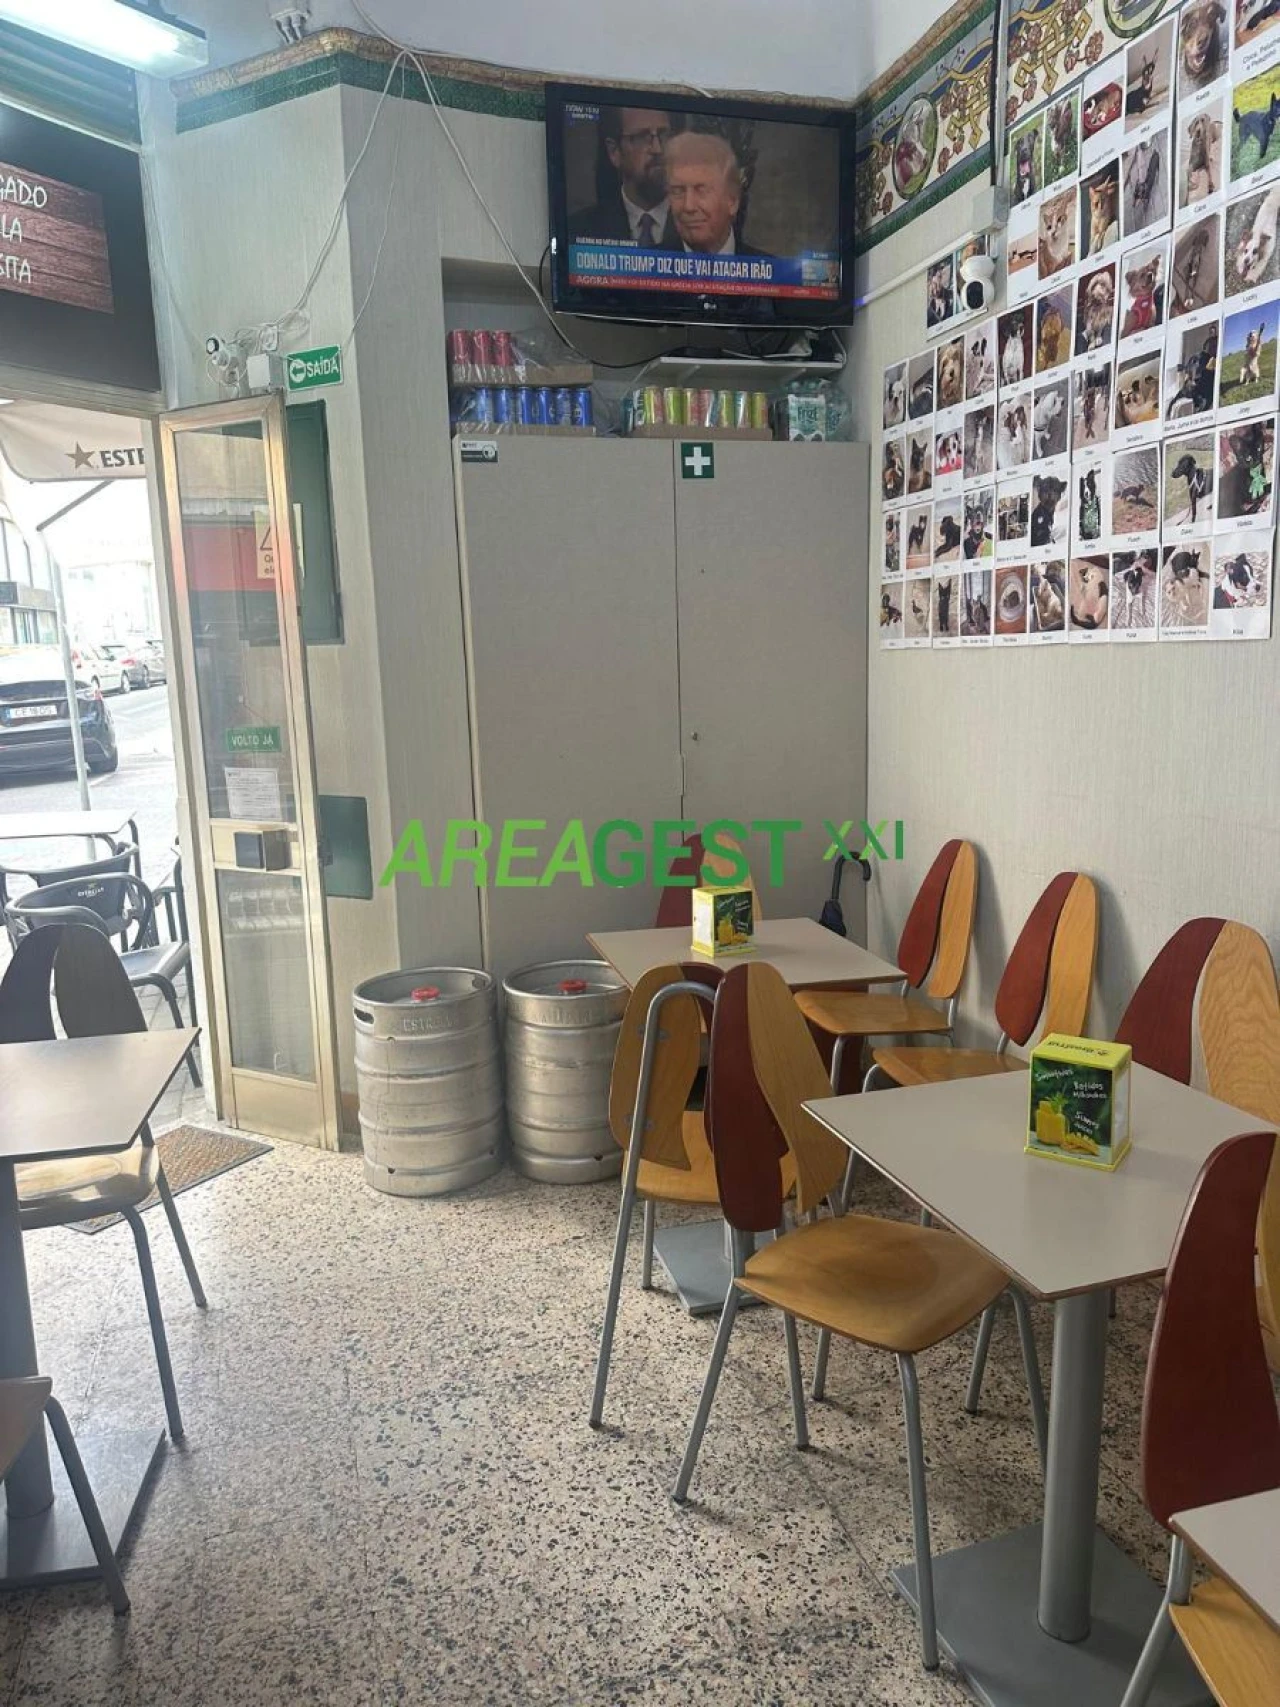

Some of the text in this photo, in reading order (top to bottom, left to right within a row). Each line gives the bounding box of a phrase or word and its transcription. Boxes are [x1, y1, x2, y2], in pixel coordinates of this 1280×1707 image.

[0, 213, 22, 243] LA
[576, 252, 772, 280] DONALD TRUMP DIZ QUE VAI ATACAR IRÃO
[576, 275, 608, 285] AGORA
[306, 355, 339, 378] SAÍDA
[231, 734, 260, 746] VOLTO
